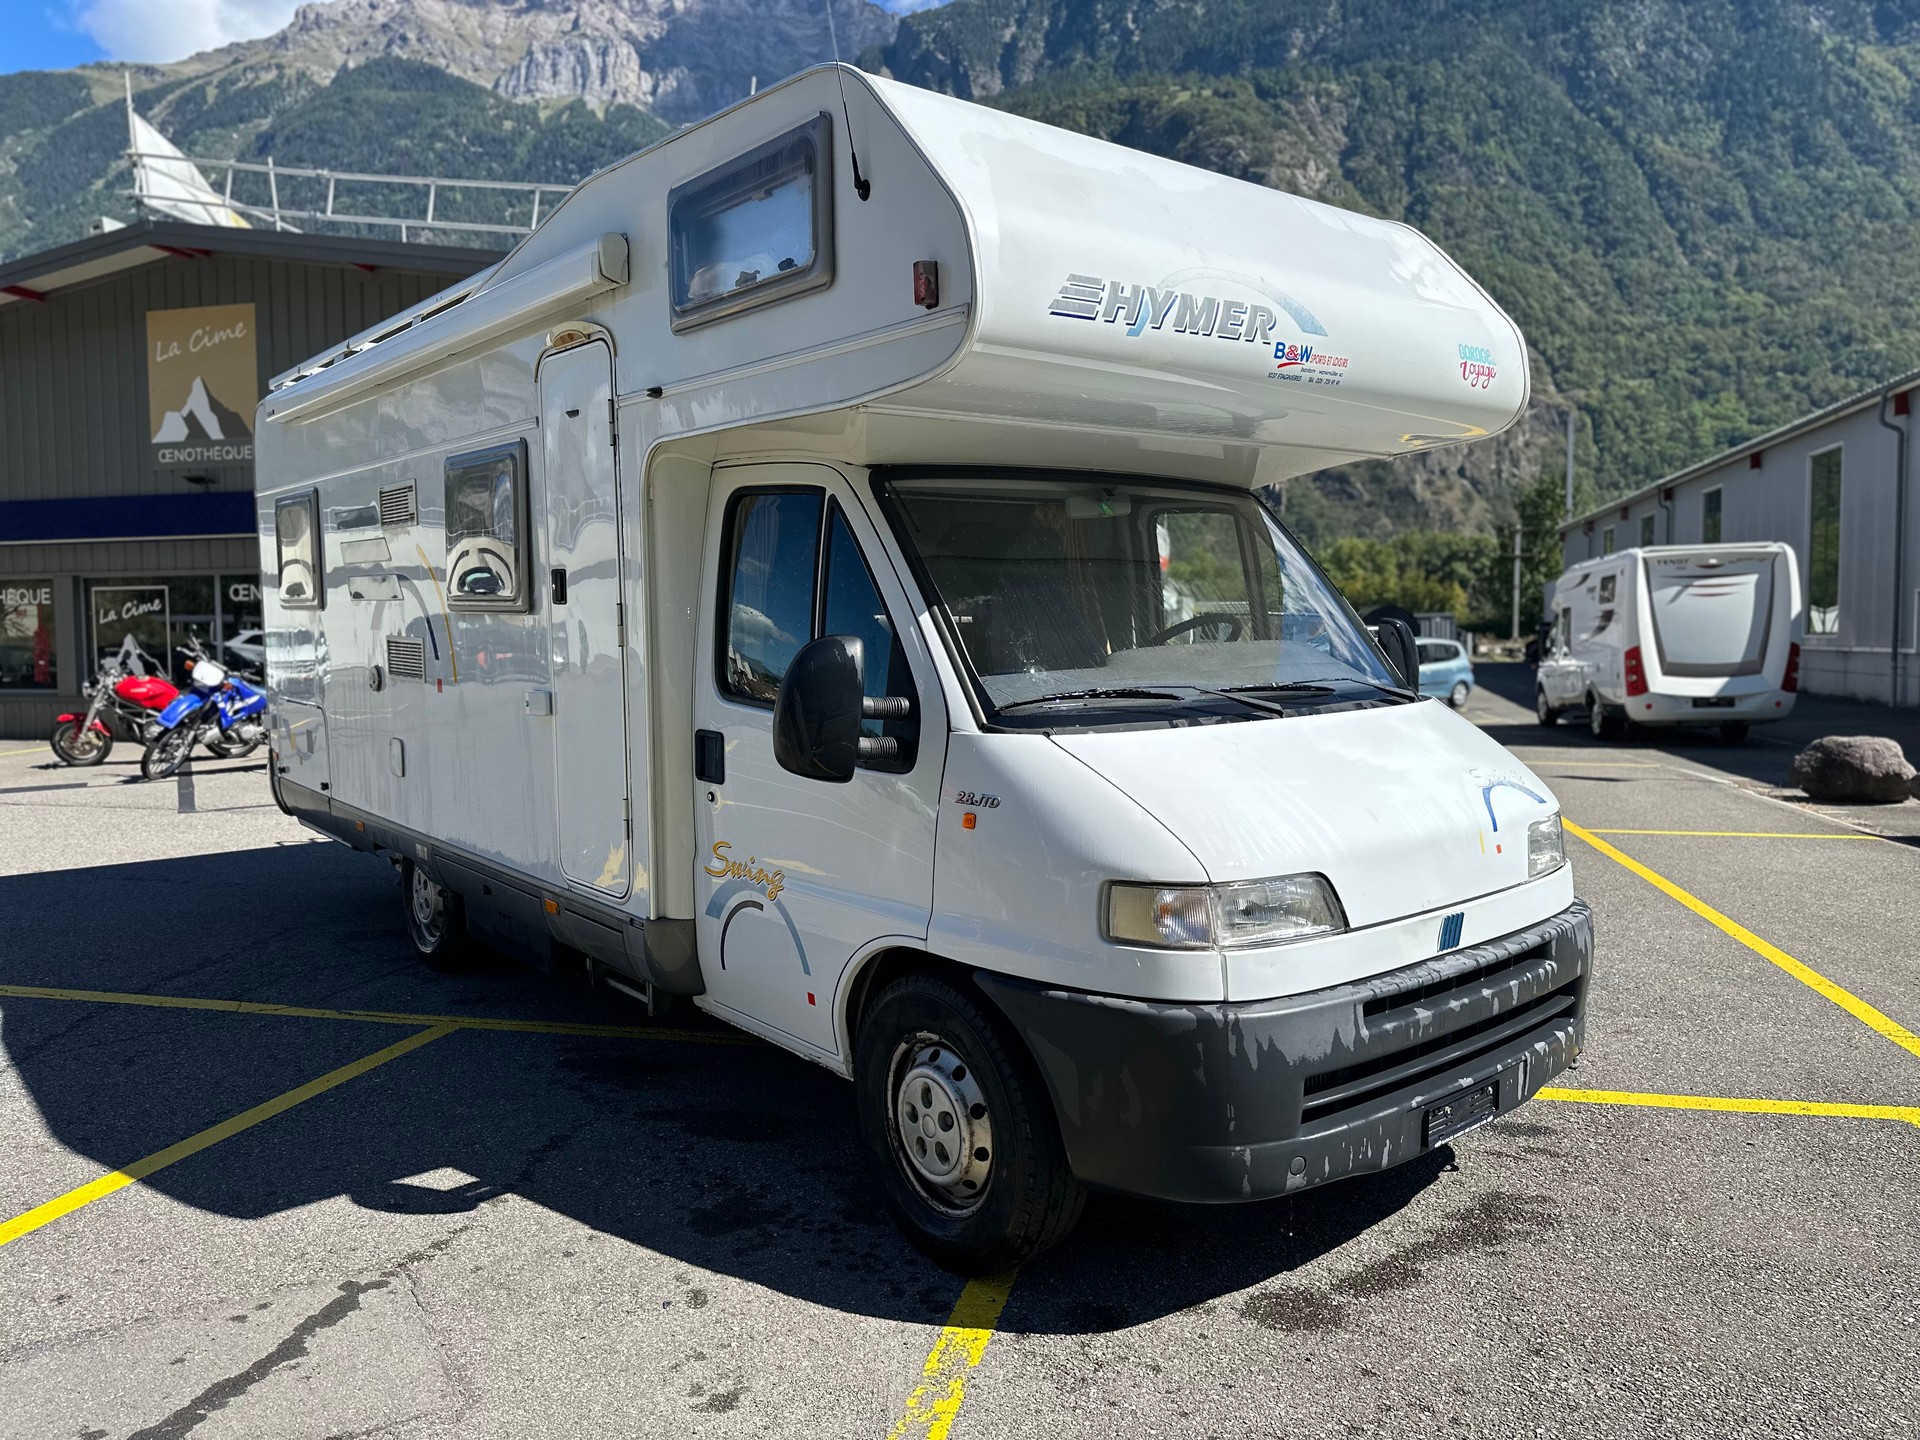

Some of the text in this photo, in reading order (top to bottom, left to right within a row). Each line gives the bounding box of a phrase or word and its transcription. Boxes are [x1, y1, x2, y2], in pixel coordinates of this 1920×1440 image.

[1102, 280, 1277, 345] HYMER
[156, 322, 247, 362] La Cime
[1273, 341, 1313, 363] B&W
[1460, 361, 1497, 389] Voyage
[100, 598, 162, 624] La Cime
[704, 841, 785, 901] Swing
